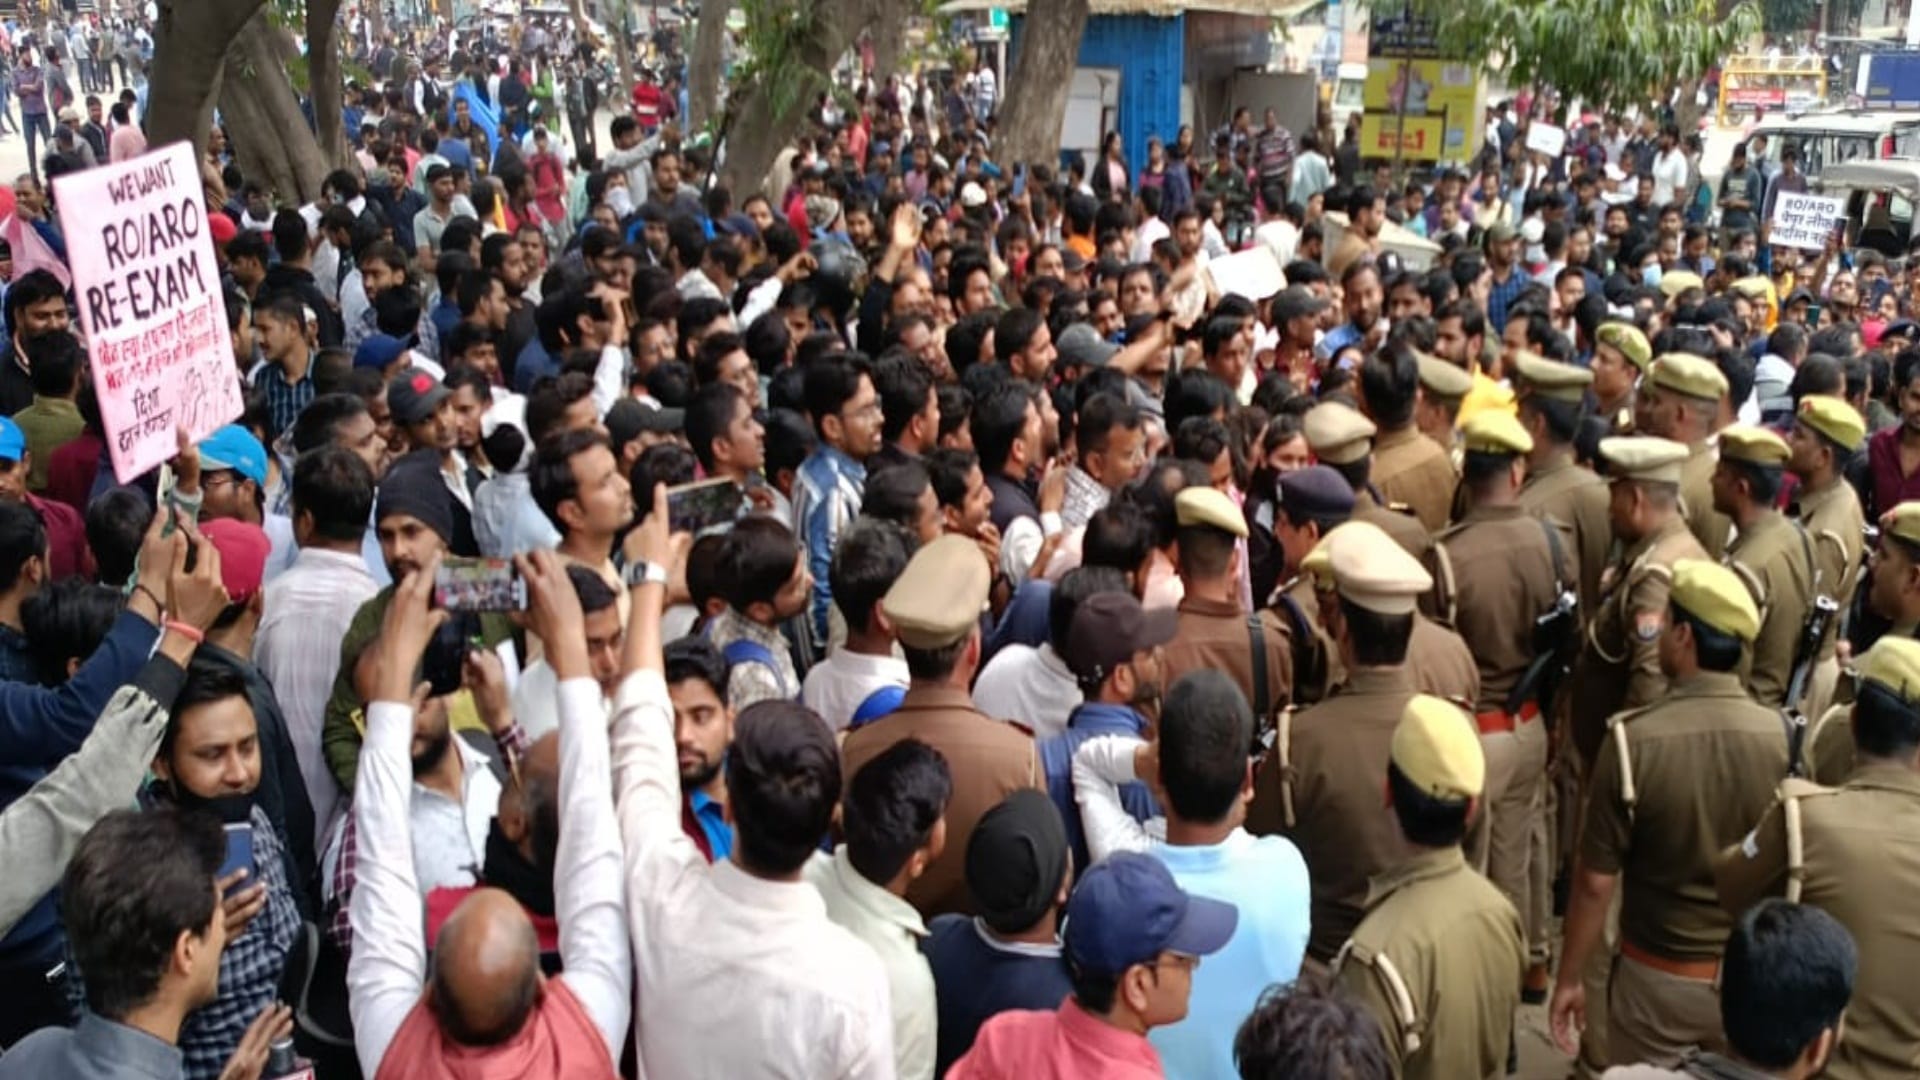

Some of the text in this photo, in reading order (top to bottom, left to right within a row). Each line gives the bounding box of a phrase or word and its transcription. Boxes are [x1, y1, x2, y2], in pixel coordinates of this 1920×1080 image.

[107, 158, 175, 205] WE WANT
[1785, 198, 1834, 213] RO/ARO
[102, 197, 199, 271] RO/ARO
[86, 250, 206, 335] RE-EXAM
[131, 386, 160, 419] दिशा
